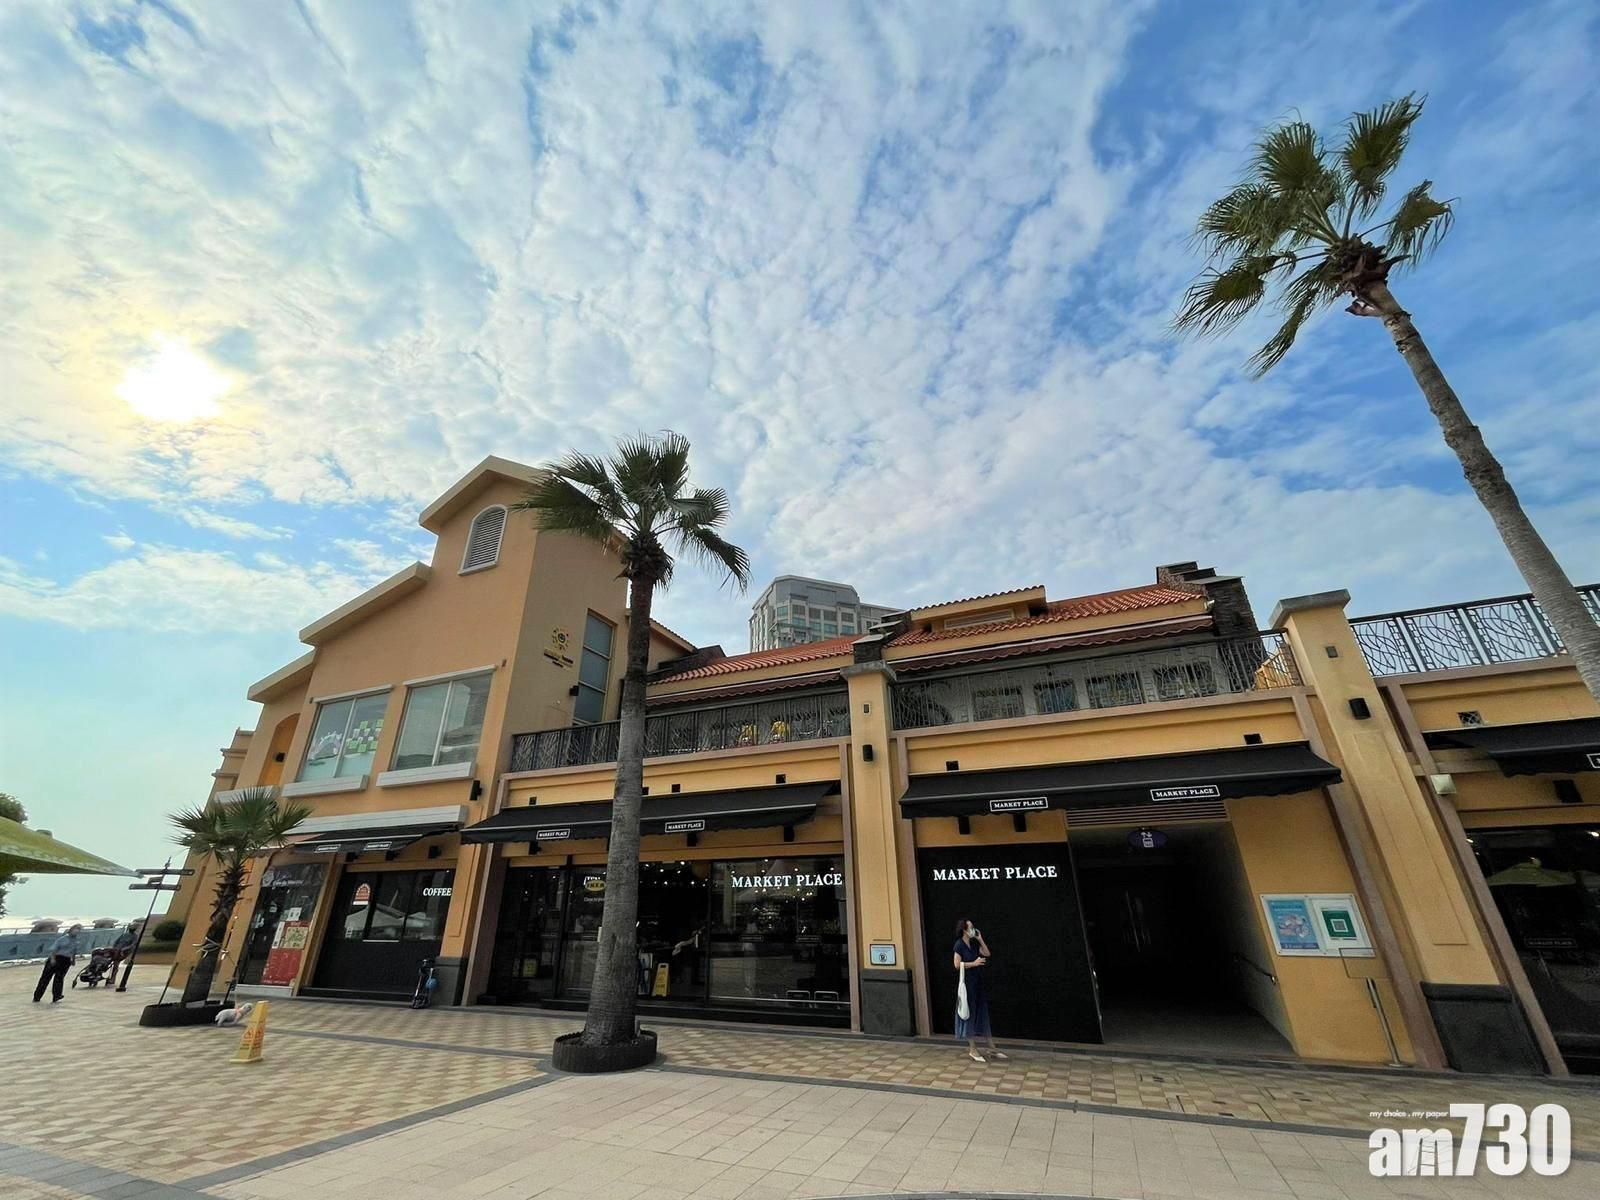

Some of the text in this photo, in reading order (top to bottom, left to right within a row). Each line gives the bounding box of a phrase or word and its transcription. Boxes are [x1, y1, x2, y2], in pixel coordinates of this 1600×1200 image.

[933, 866, 1057, 880] MARKET PLACE
[731, 873, 843, 888] MARKET PLACE
[422, 887, 452, 897] COFFEE
